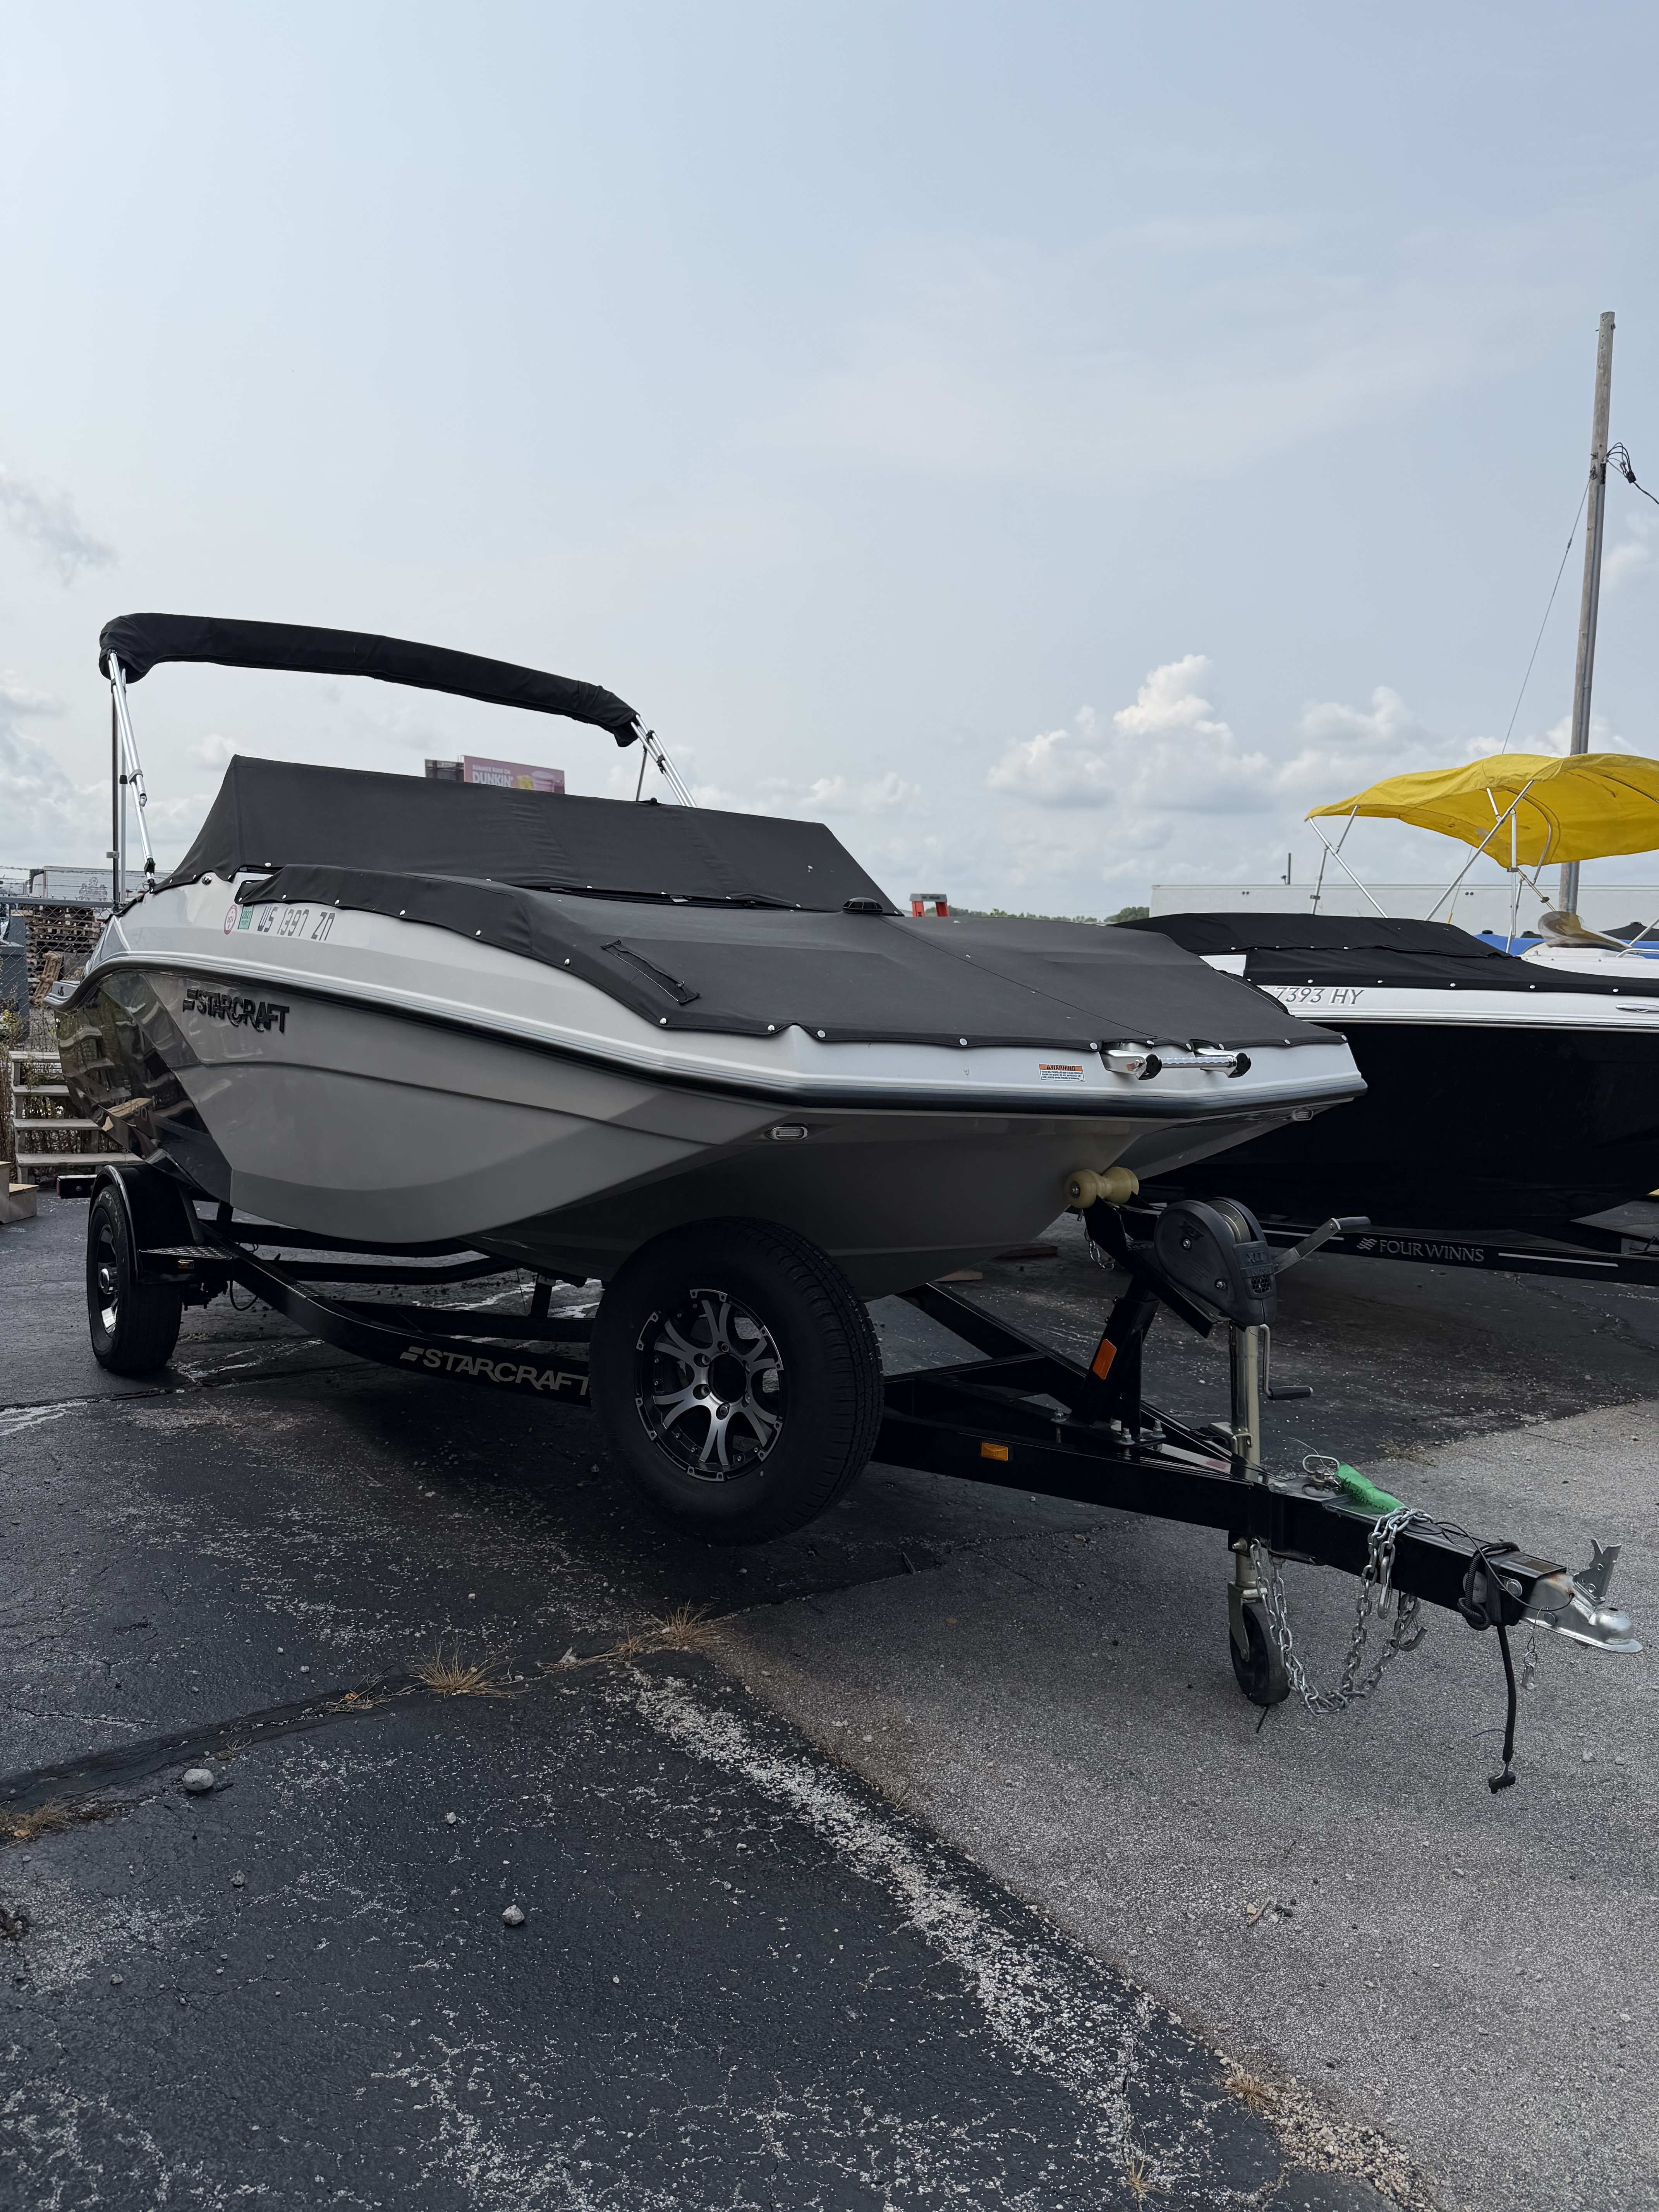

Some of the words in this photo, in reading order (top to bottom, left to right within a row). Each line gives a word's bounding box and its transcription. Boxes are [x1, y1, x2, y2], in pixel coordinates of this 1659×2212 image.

[472, 771, 514, 788] DUNKIN'
[257, 906, 279, 933] WS
[277, 908, 309, 937] 1397
[1276, 987, 1326, 1003] 7393
[1330, 989, 1365, 1005] HY
[197, 989, 290, 1034] STARCRAFT
[1246, 1251, 1264, 1263] XLT
[1379, 1239, 1424, 1256] FOUR
[1425, 1244, 1484, 1262] WINNS
[423, 1349, 589, 1396] STARCRAFT
